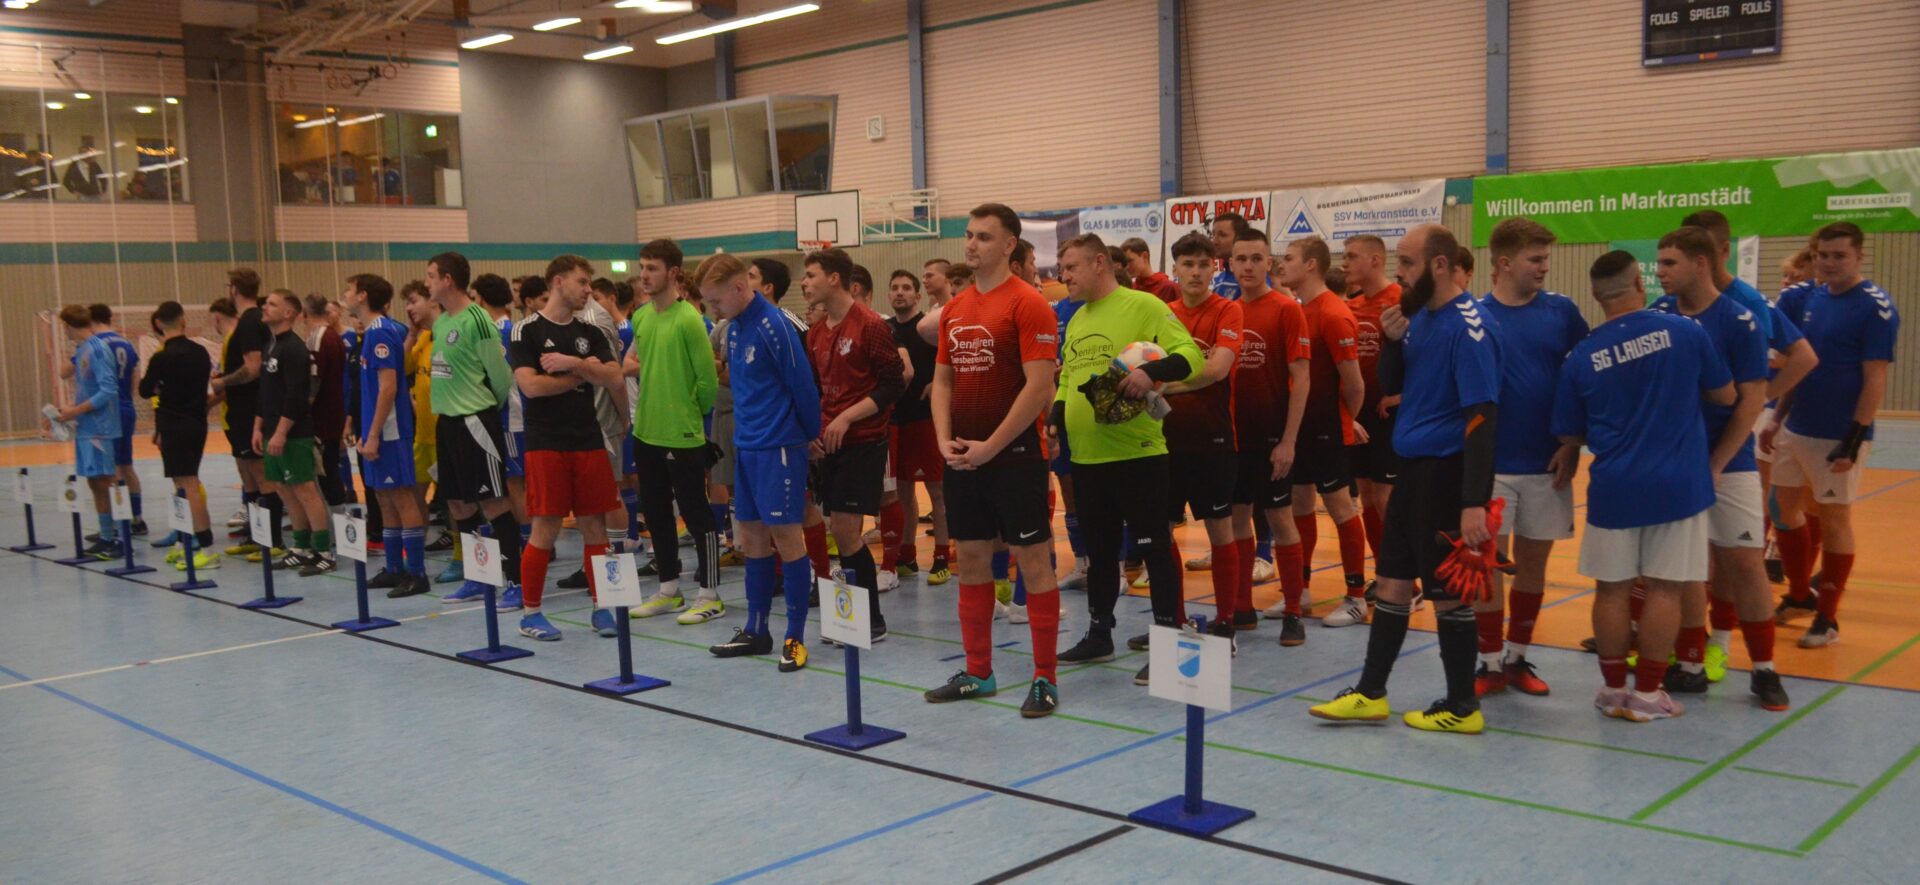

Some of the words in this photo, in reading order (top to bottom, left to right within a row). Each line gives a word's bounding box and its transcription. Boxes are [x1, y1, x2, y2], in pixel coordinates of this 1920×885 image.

[1650, 12, 1678, 26] FOULS
[1689, 5, 1730, 21] SPIELER
[1741, 1, 1772, 15] FOULS
[1170, 202, 1208, 226] CITY
[1215, 196, 1266, 221] PIZZA
[1334, 211, 1351, 222] SSV
[1353, 206, 1418, 220] Markranstädt
[1421, 207, 1440, 217] e.V.
[1486, 198, 1593, 217] Willkommen
[1600, 194, 1617, 212] in
[1621, 186, 1752, 210] Markranstädt
[1083, 219, 1103, 230] GLAS
[1104, 219, 1110, 229] &
[1111, 217, 1143, 229] SPIEGEL
[116, 346, 128, 379] 9
[1591, 349, 1613, 372] SG
[1614, 329, 1672, 364] LAUSEN
[960, 683, 979, 695] FILA
